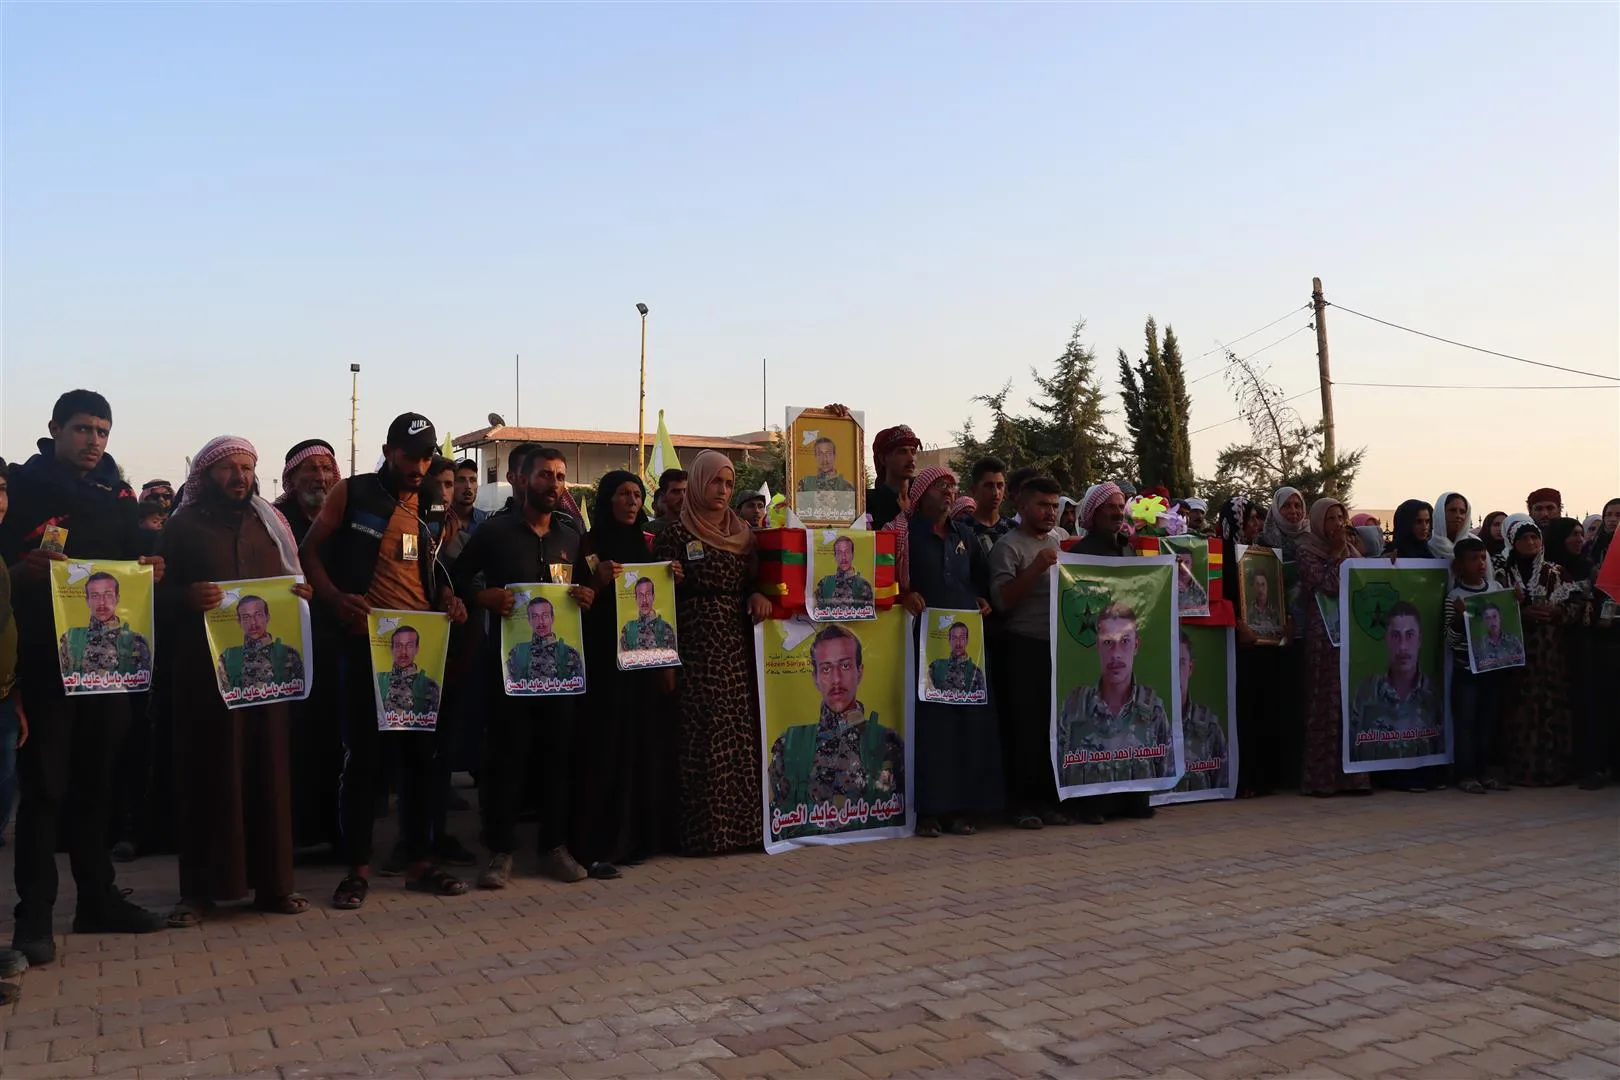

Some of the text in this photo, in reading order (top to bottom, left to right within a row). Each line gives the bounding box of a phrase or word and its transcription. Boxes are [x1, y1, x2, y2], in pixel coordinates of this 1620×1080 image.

[64, 670, 150, 689] الشهيد باسل عايد الحس
[279, 679, 304, 695] الشهيد
[528, 678, 544, 692] عايد
[543, 678, 561, 692] باسل
[561, 676, 584, 691] الشهيد
[242, 685, 261, 700] عايد
[260, 682, 279, 698] باسل
[1063, 749, 1088, 769] الخضر
[1088, 750, 1111, 763] محمد
[1134, 743, 1166, 760] الشهيد
[771, 793, 904, 835] الشهيد باسل عايد الحسن
